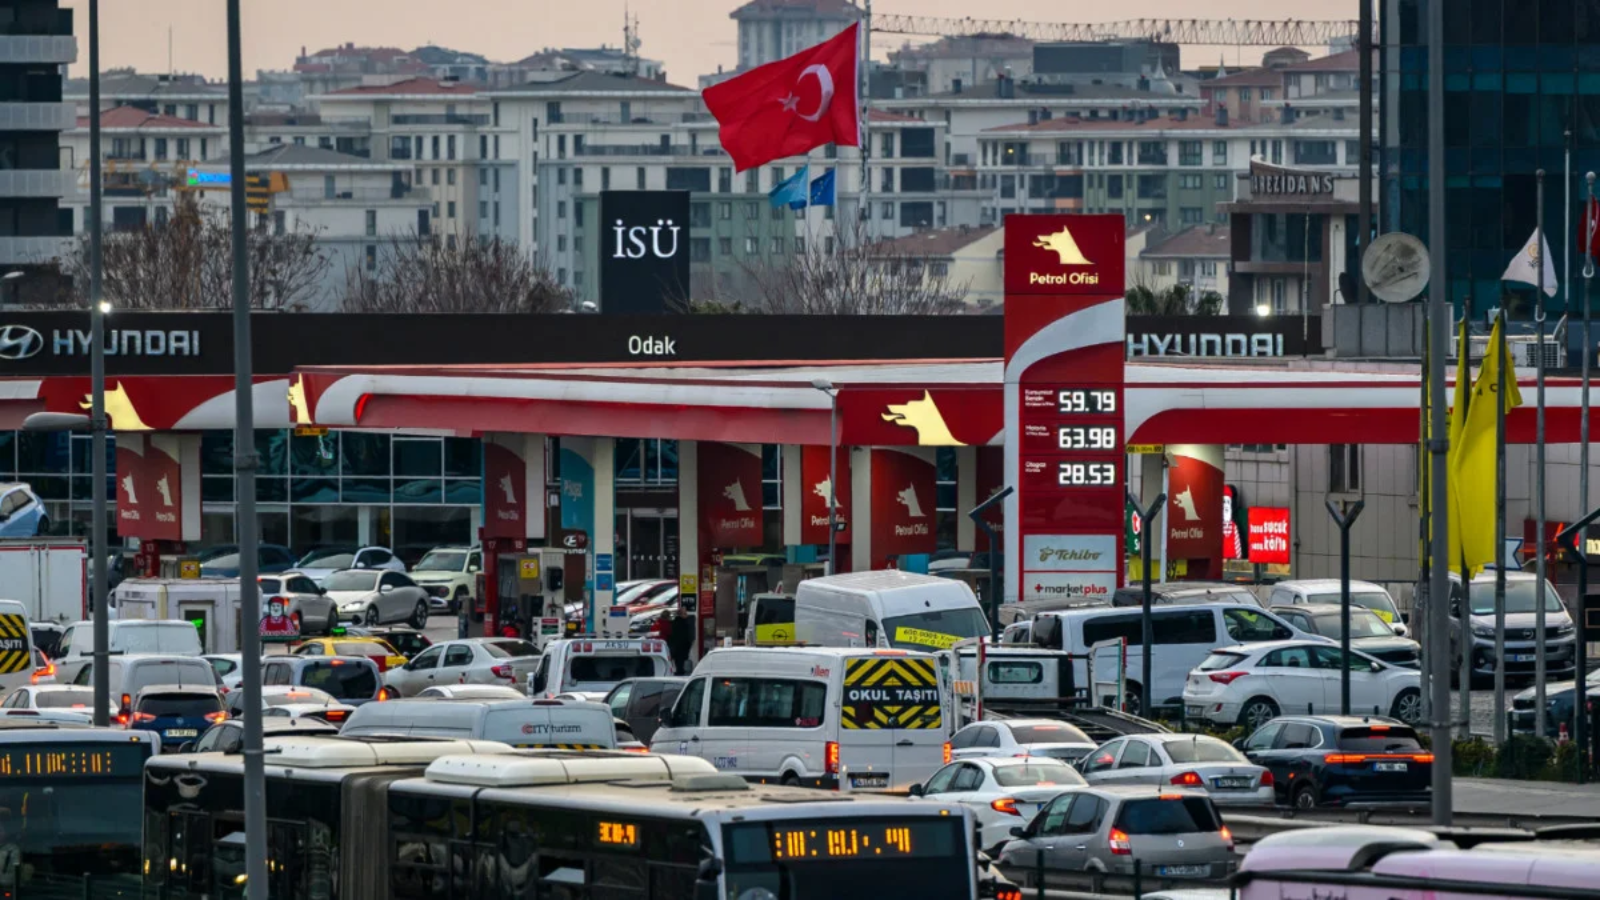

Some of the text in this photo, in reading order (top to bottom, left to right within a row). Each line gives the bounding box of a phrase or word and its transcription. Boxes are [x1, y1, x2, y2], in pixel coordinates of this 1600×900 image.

[612, 218, 681, 259] İSÜ
[1030, 272, 1099, 285] Petrol Ofisi
[53, 329, 200, 356] HYUNDAI
[628, 335, 676, 355] Odak
[1127, 333, 1284, 357] HYUNDAI
[1059, 391, 1116, 412] 59.79
[1059, 428, 1116, 449] 63.98
[1059, 464, 1116, 485] 28.53
[895, 525, 914, 536] Petrol
[1171, 528, 1189, 539] Petrol
[1055, 548, 1102, 561] Tchibo
[848, 689, 938, 703] OKUL TAŞITI
